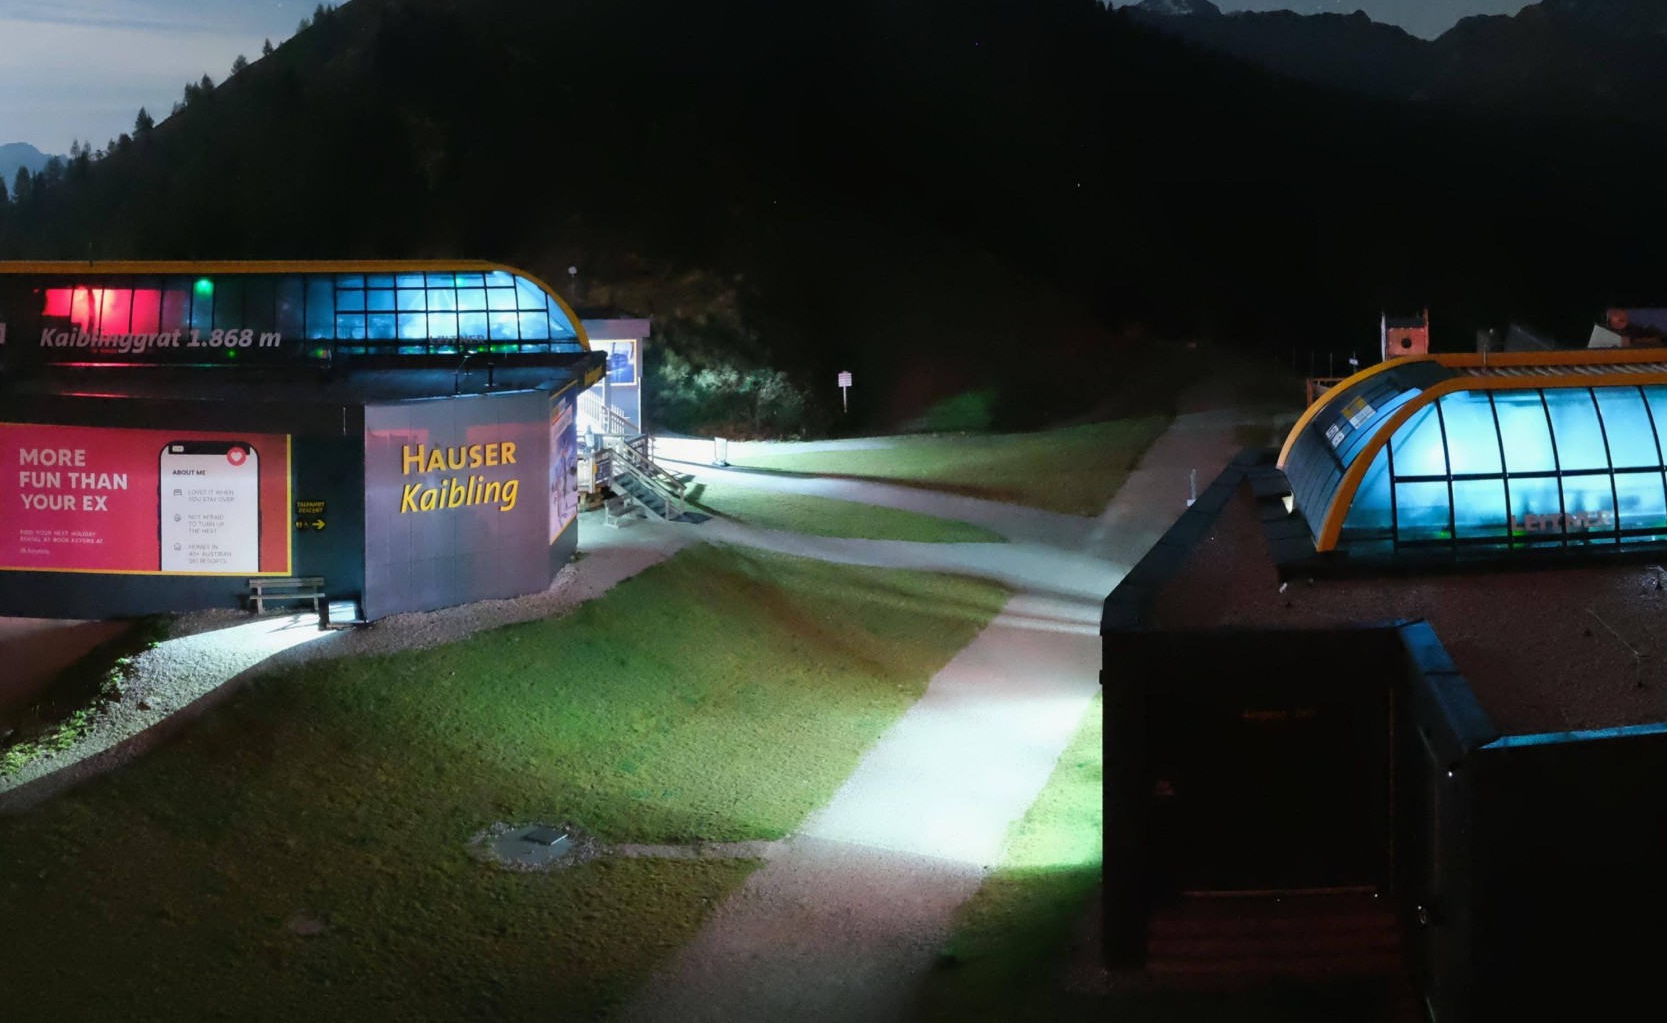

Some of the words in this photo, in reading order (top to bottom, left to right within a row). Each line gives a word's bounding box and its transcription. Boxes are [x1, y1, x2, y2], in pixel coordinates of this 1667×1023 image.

[40, 328, 182, 353] Kaiblinggrat
[187, 328, 253, 347] 1.868
[259, 331, 282, 347] m
[19, 448, 86, 466] MORE
[402, 441, 517, 475] HAUSER
[19, 471, 60, 488] FUN
[68, 473, 128, 490] THAN
[20, 494, 76, 511] YOUR
[82, 495, 108, 511] EX
[400, 475, 519, 513] Kaibling
[1511, 510, 1613, 531] LEITNER
